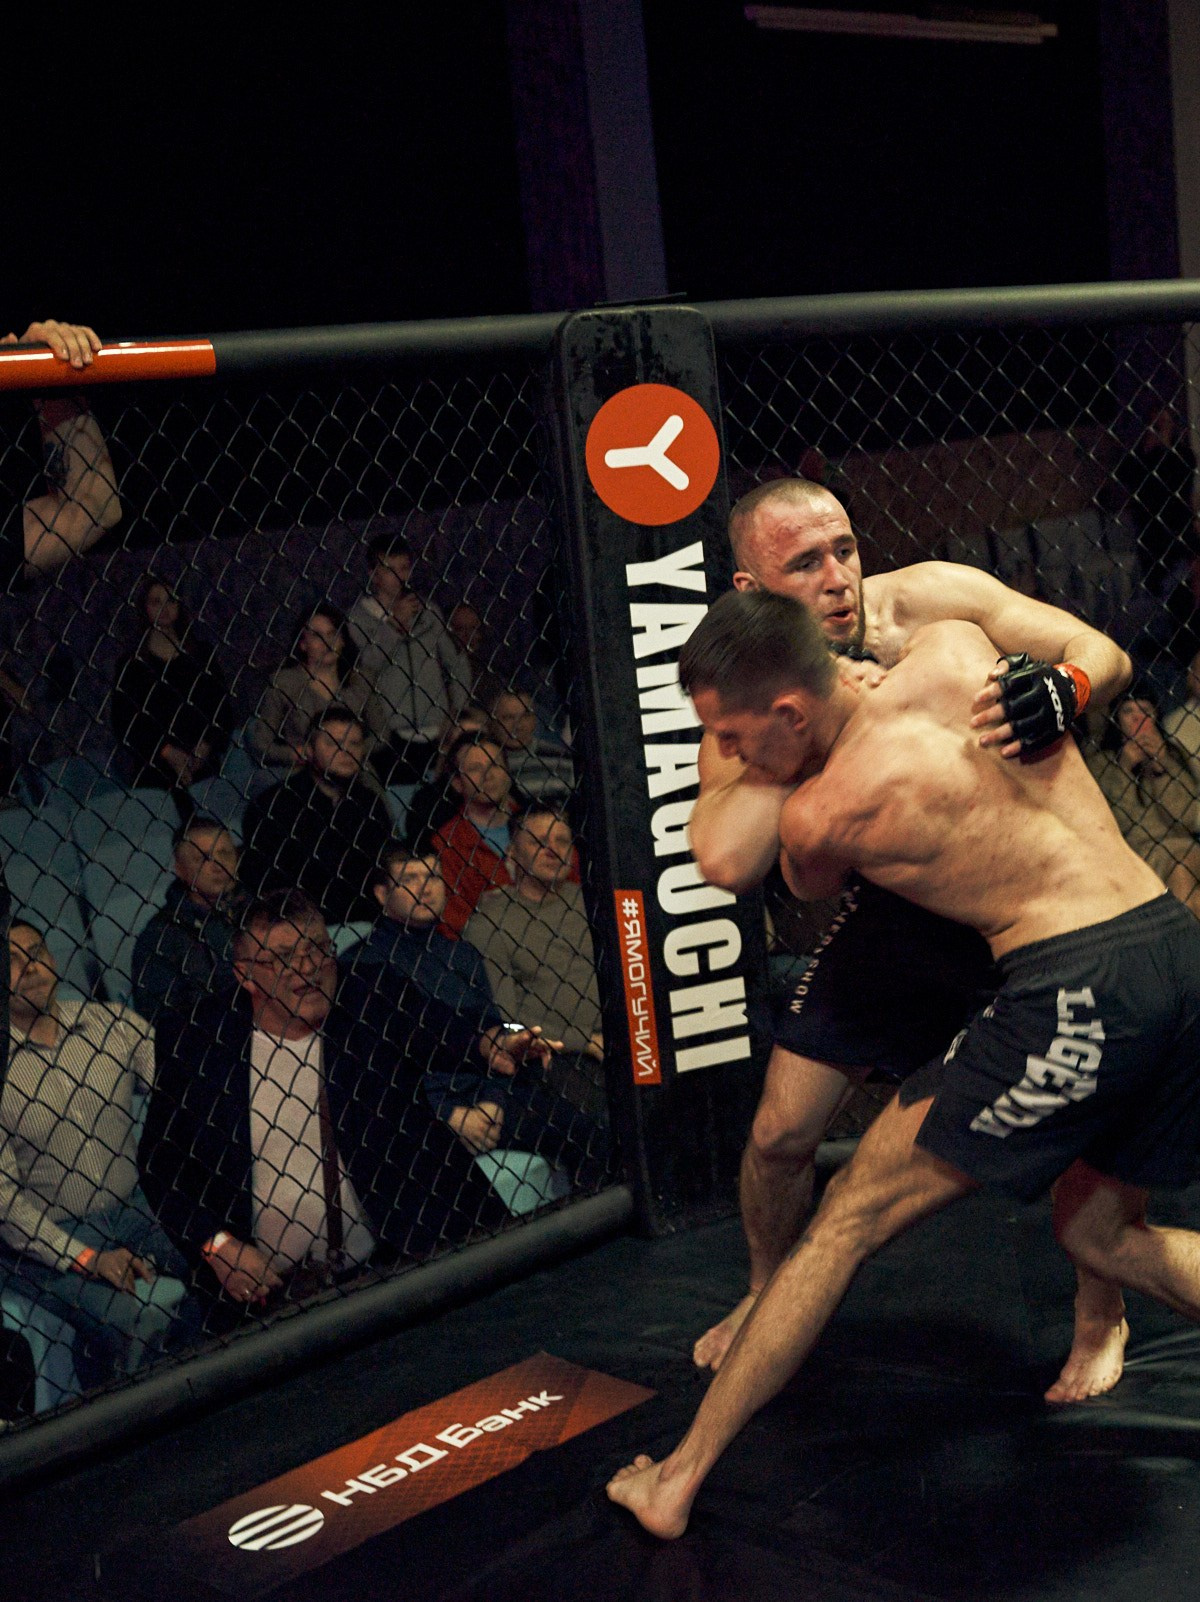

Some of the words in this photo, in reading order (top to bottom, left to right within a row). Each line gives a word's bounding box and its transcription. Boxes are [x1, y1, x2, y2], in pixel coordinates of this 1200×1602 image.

[1043, 675, 1066, 733] RDX
[621, 897, 657, 1077] #ЯМОГУЧИЙ
[320, 1442, 449, 1507] НБД
[435, 1390, 565, 1449] Банк
